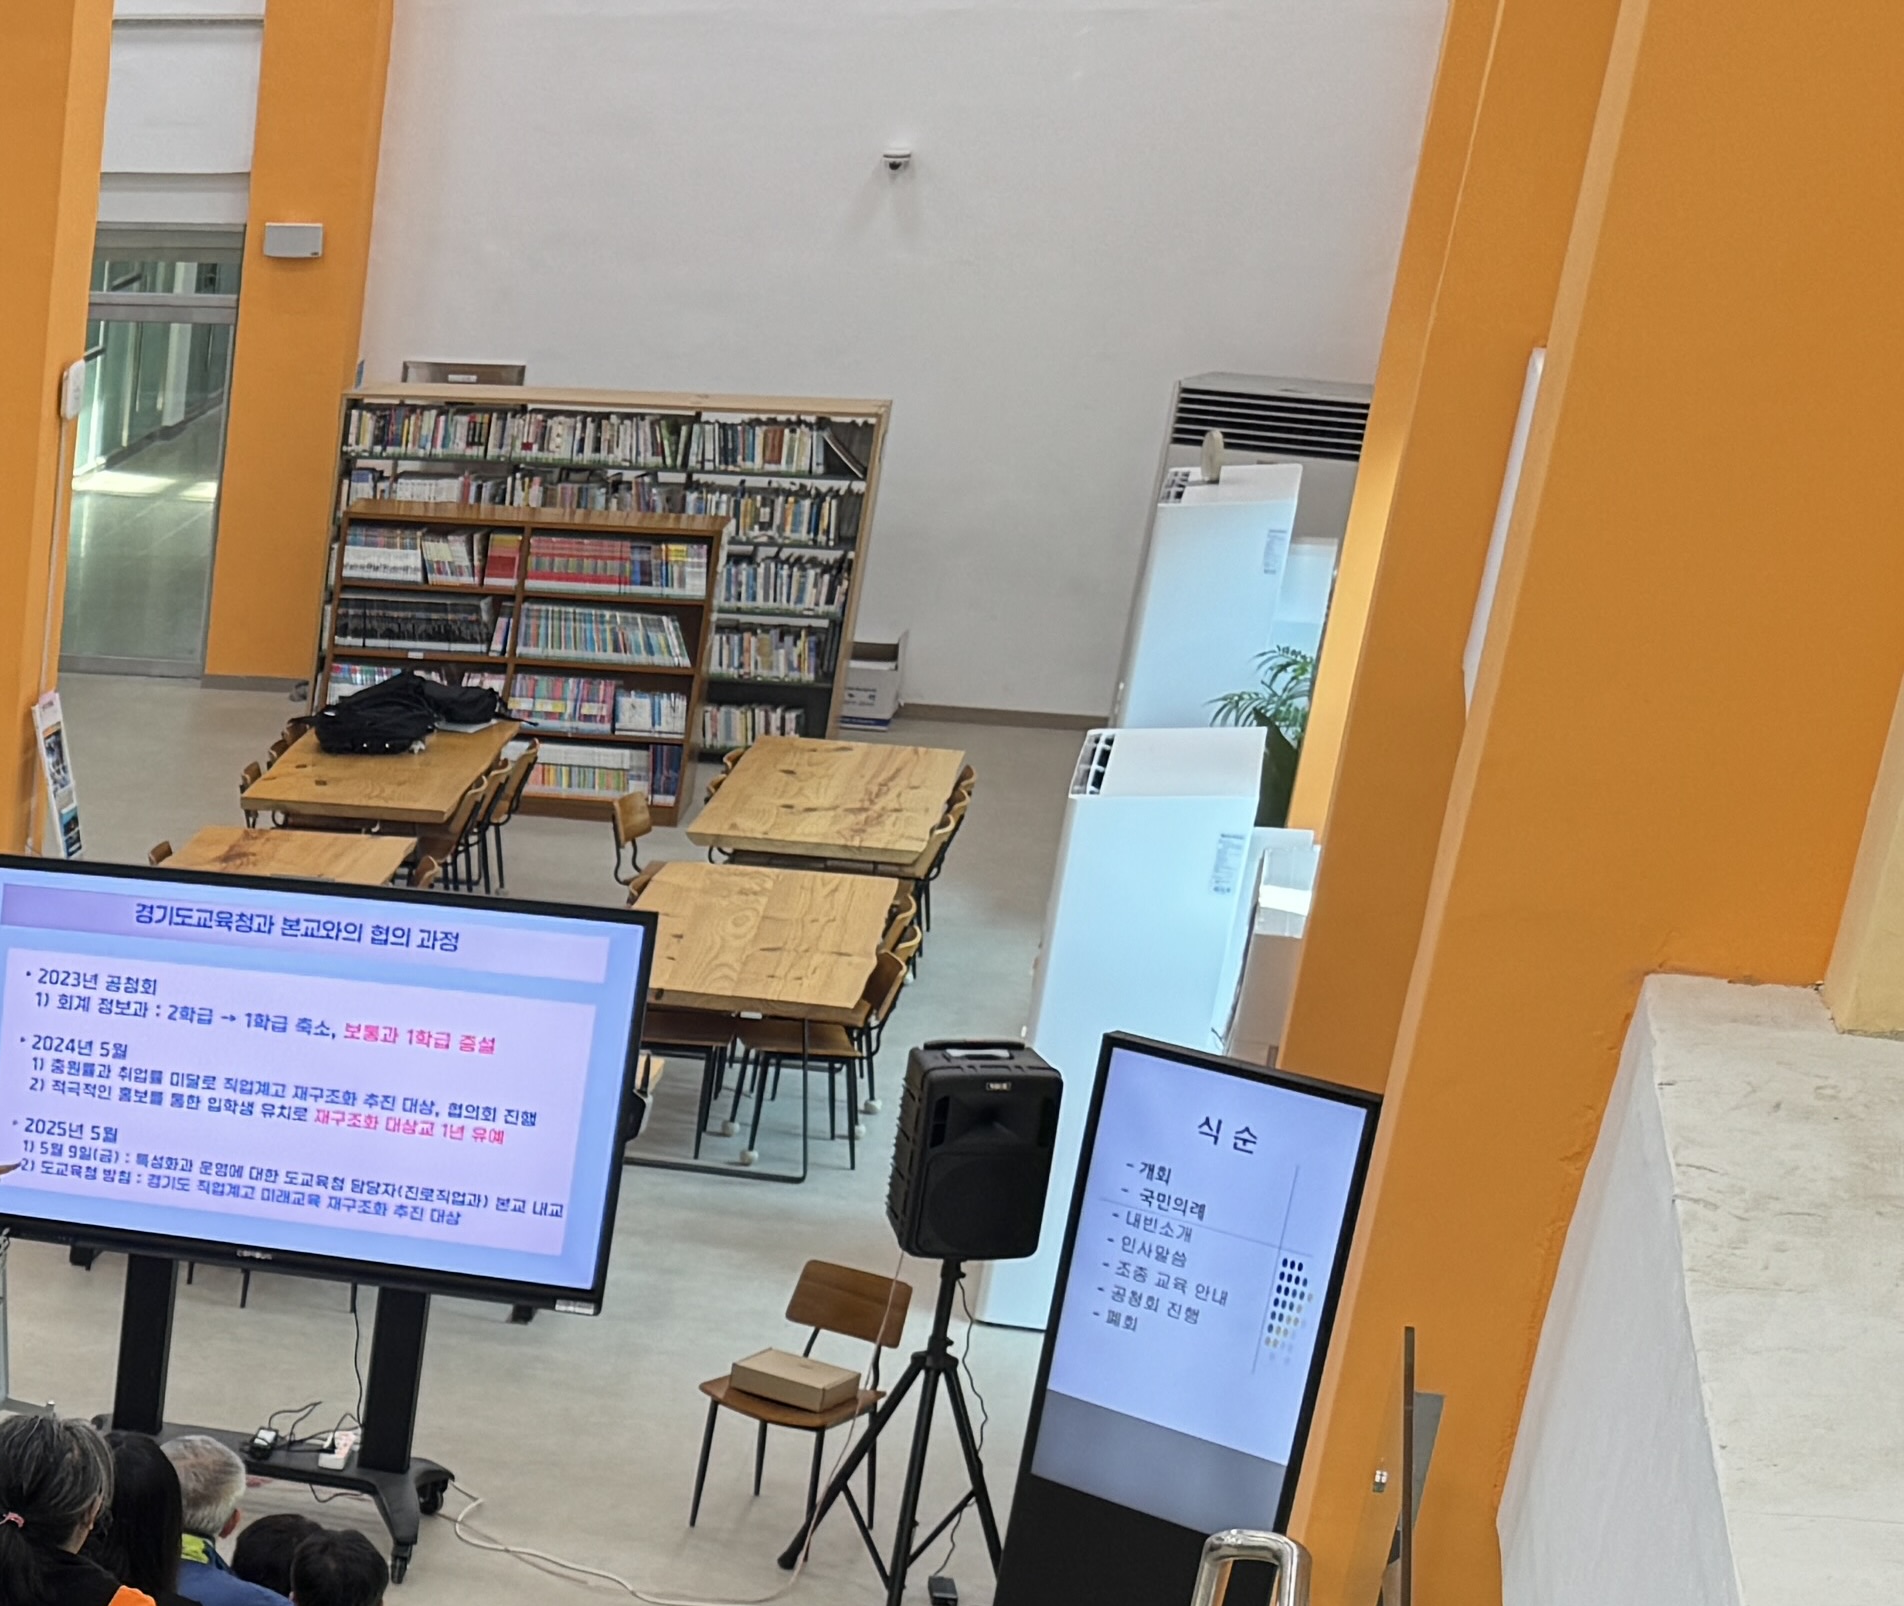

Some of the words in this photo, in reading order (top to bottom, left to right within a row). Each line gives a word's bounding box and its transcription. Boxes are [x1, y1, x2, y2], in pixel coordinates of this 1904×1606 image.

[135, 902, 275, 935] 경기도교육청과
[281, 916, 363, 944] 본교와의
[371, 923, 412, 948] 협의
[417, 927, 460, 952] 과정
[37, 968, 99, 990] 2023년
[105, 974, 158, 996] 공청회
[36, 992, 50, 1008] 1)
[57, 993, 91, 1013] 회계
[98, 997, 148, 1019] 정보과
[167, 1004, 214, 1026] 2학급
[244, 1012, 288, 1033] 1학급
[295, 1017, 336, 1040] 축소,
[344, 1022, 399, 1044] 보통과
[407, 1028, 451, 1050] 1학급
[458, 1034, 496, 1055] 증설
[31, 1034, 93, 1057] 2024년
[99, 1041, 128, 1060] 5월
[32, 1057, 45, 1072] 1)
[118, 1065, 163, 1085] 취업률
[169, 1071, 217, 1091] 미달로
[223, 1076, 287, 1099] 직업계고
[292, 1085, 358, 1107] 재구조화
[363, 1092, 396, 1112] 추진
[402, 1097, 440, 1118] 대상,
[447, 1101, 497, 1123] 협의회
[503, 1108, 537, 1127] 진행
[29, 1077, 45, 1092] 2)
[51, 1079, 112, 1101] 적극적인
[118, 1086, 164, 1106] 홍보를
[170, 1092, 201, 1110] 통한
[207, 1096, 255, 1117] 입학생
[261, 1102, 308, 1122] 유치로
[313, 1108, 379, 1130] 재구조화
[385, 1116, 435, 1137] 대상교
[442, 1122, 465, 1141] 1년
[471, 1126, 505, 1145] 유예
[24, 1117, 84, 1140] 2025년
[90, 1125, 118, 1144] 5월
[23, 1139, 35, 1153] 1)
[39, 1141, 64, 1157] 5월
[68, 1144, 120, 1164] 9일(금)
[136, 1152, 193, 1173] 특성화과
[199, 1160, 244, 1179] 운영에
[248, 1165, 279, 1184] 대한
[283, 1170, 345, 1192] 도교육청
[351, 1178, 489, 1209] 담당자(진로직업과)
[495, 1196, 526, 1214] 본교
[532, 1200, 564, 1218] 내교
[1138, 1160, 1172, 1187] 개회
[20, 1158, 35, 1172] 2)
[40, 1160, 98, 1181] 도교육청
[102, 1168, 132, 1185] 방침
[147, 1173, 192, 1192] 경기도
[196, 1179, 256, 1200] 직업계고
[260, 1187, 321, 1208] 미래교육
[326, 1195, 388, 1217] 재구조화
[392, 1203, 425, 1222] 추진
[429, 1207, 462, 1226] 대상
[1139, 1187, 1206, 1221] 국민의례
[1125, 1209, 1193, 1243] 내빈소개
[1121, 1235, 1188, 1269] 인사말씀
[1111, 1283, 1160, 1313] 공청회
[1166, 1300, 1200, 1325] 진행
[1154, 1271, 1189, 1295] 교육
[1194, 1283, 1229, 1307] 안내
[1105, 1309, 1138, 1332] 폐회
